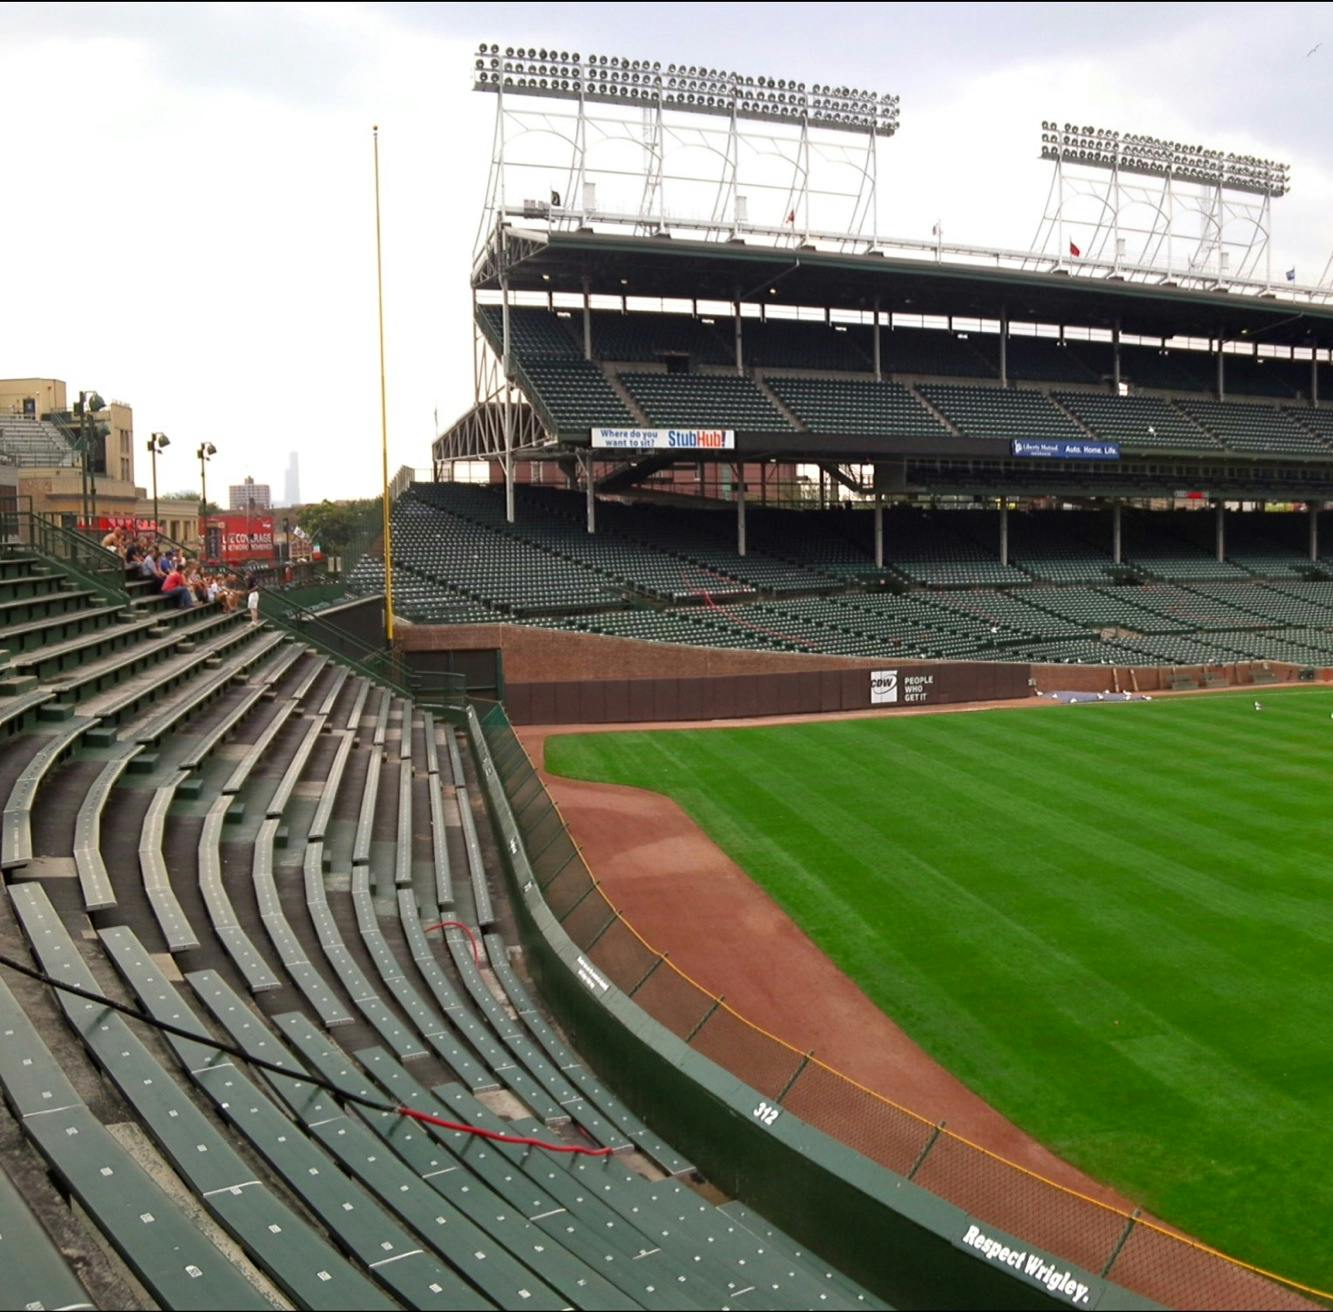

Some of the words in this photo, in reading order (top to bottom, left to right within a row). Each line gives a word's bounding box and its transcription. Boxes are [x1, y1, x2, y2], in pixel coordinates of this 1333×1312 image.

[600, 429, 628, 437] Where
[629, 429, 641, 437] do
[642, 431, 658, 440] you
[668, 430, 726, 447] StubHub!
[605, 439, 627, 447] want
[640, 439, 655, 447] sit?
[871, 678, 893, 689] CDW
[904, 675, 934, 685] PEOPLE
[904, 684, 923, 694] WHO
[904, 693, 919, 702] GET
[920, 692, 927, 702] IT
[753, 1102, 779, 1125] 312
[962, 1224, 1027, 1270] Respect
[1024, 1254, 1089, 1304] Wrigley.
